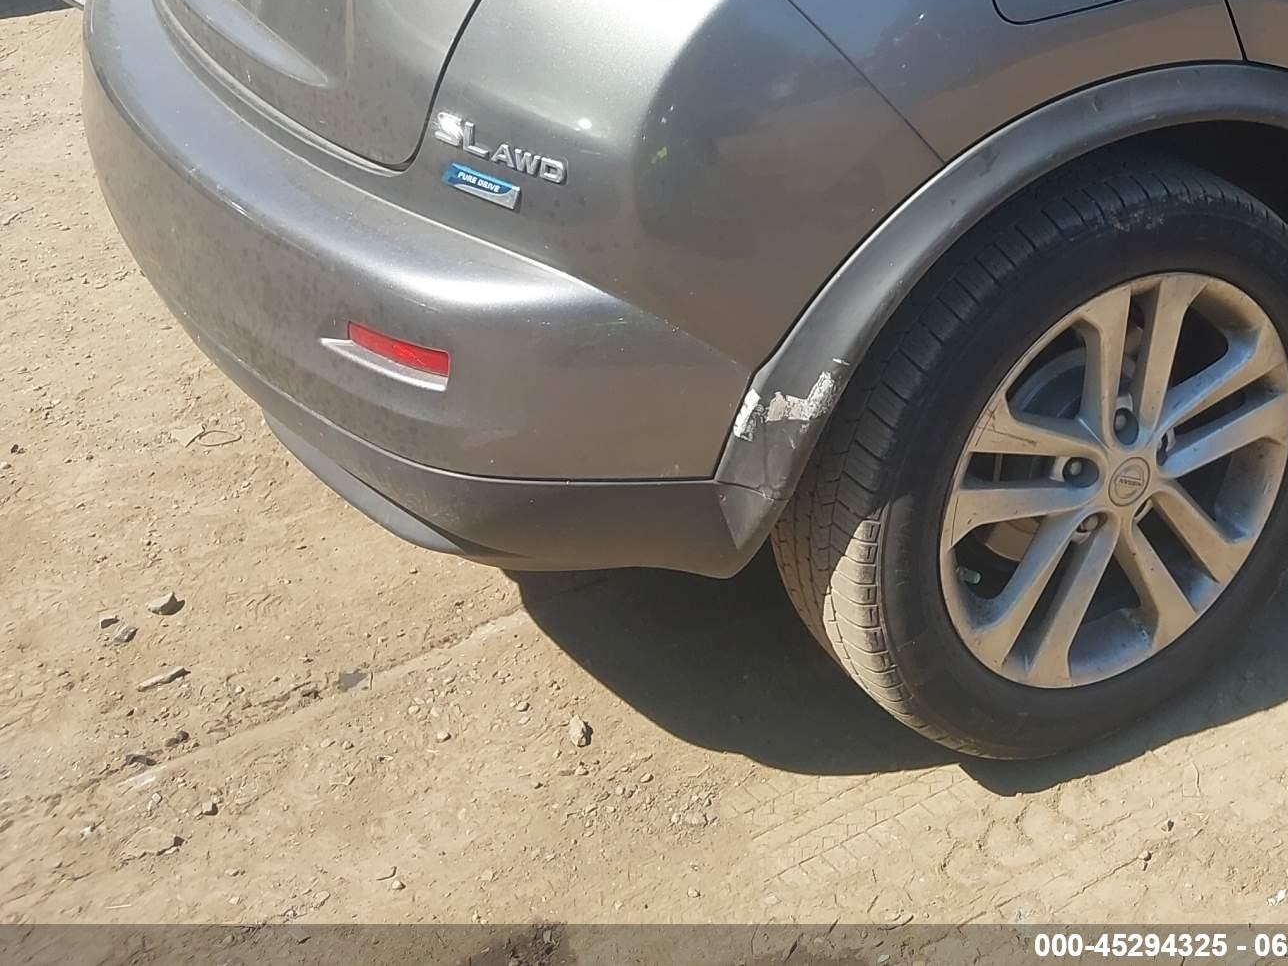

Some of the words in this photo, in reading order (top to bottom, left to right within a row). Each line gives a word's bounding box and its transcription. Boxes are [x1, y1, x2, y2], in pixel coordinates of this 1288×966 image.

[491, 143, 567, 184] AWD
[457, 171, 477, 184] PURE
[477, 178, 501, 193] DRIVE
